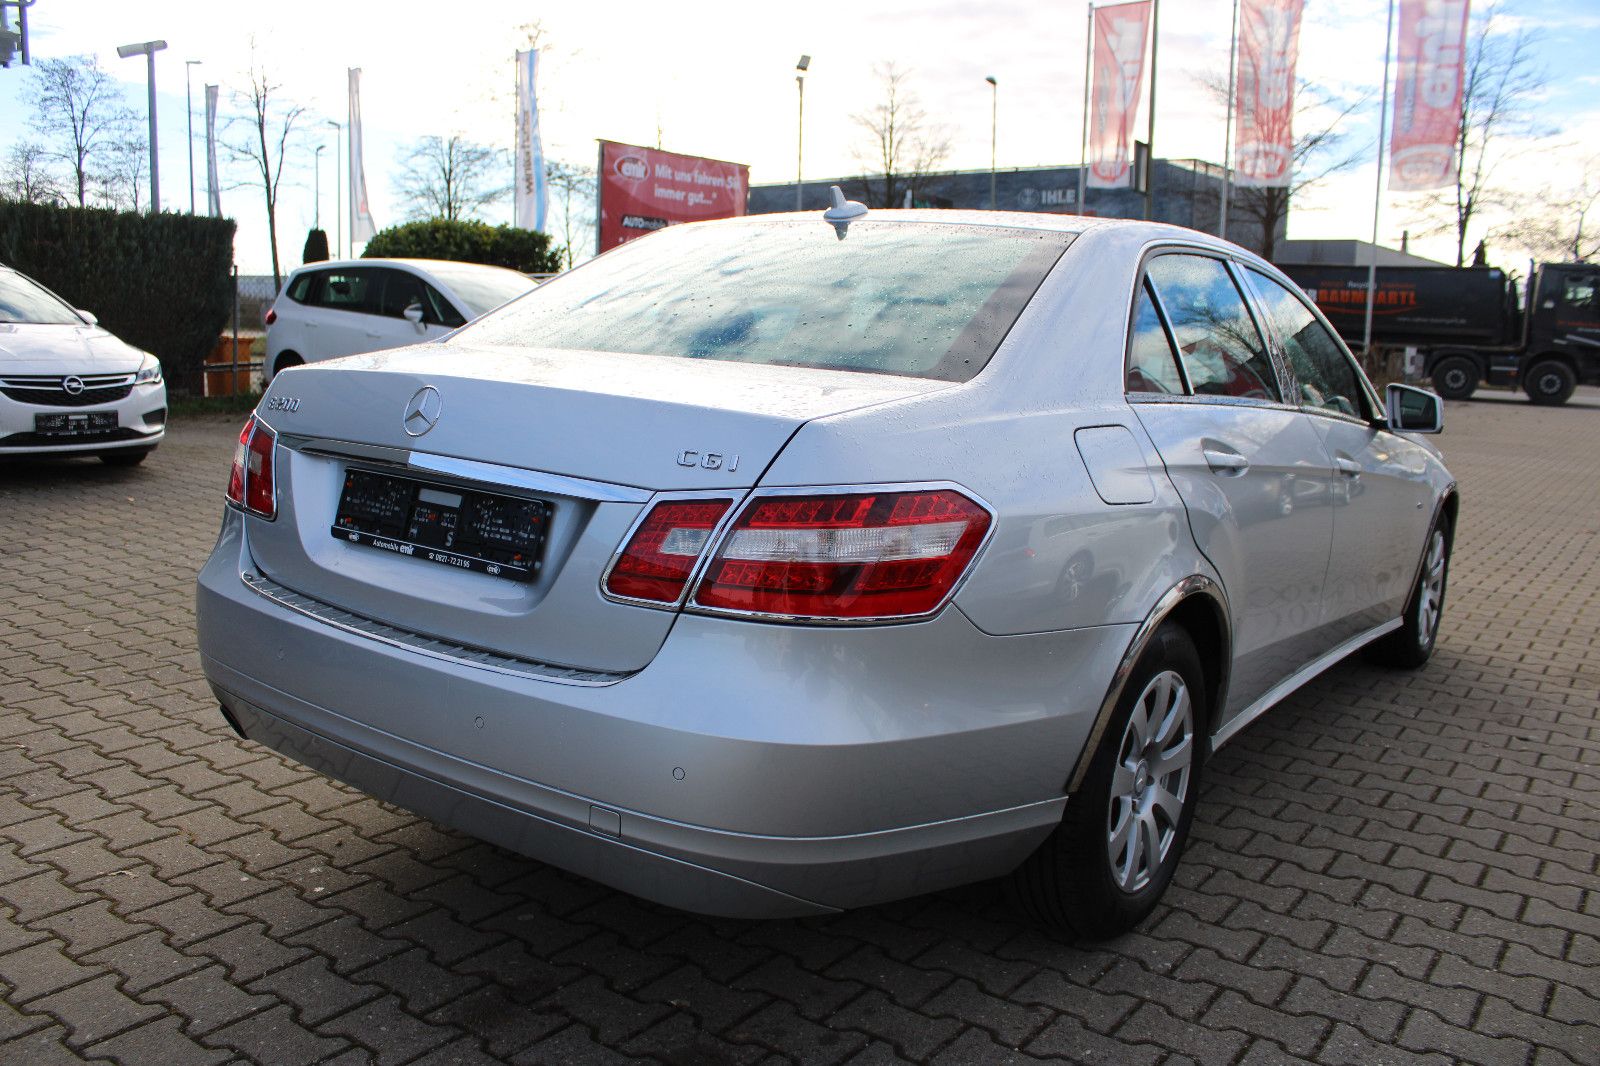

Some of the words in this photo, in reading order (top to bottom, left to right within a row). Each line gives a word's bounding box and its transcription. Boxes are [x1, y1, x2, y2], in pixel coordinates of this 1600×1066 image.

[621, 160, 645, 178] emir
[655, 164, 672, 179] Mit
[674, 170, 691, 182] uns
[693, 170, 724, 187] fahren
[654, 184, 685, 200] immer
[1042, 189, 1075, 204] IHLE
[677, 449, 739, 472] CGI
[400, 543, 414, 555] emir
